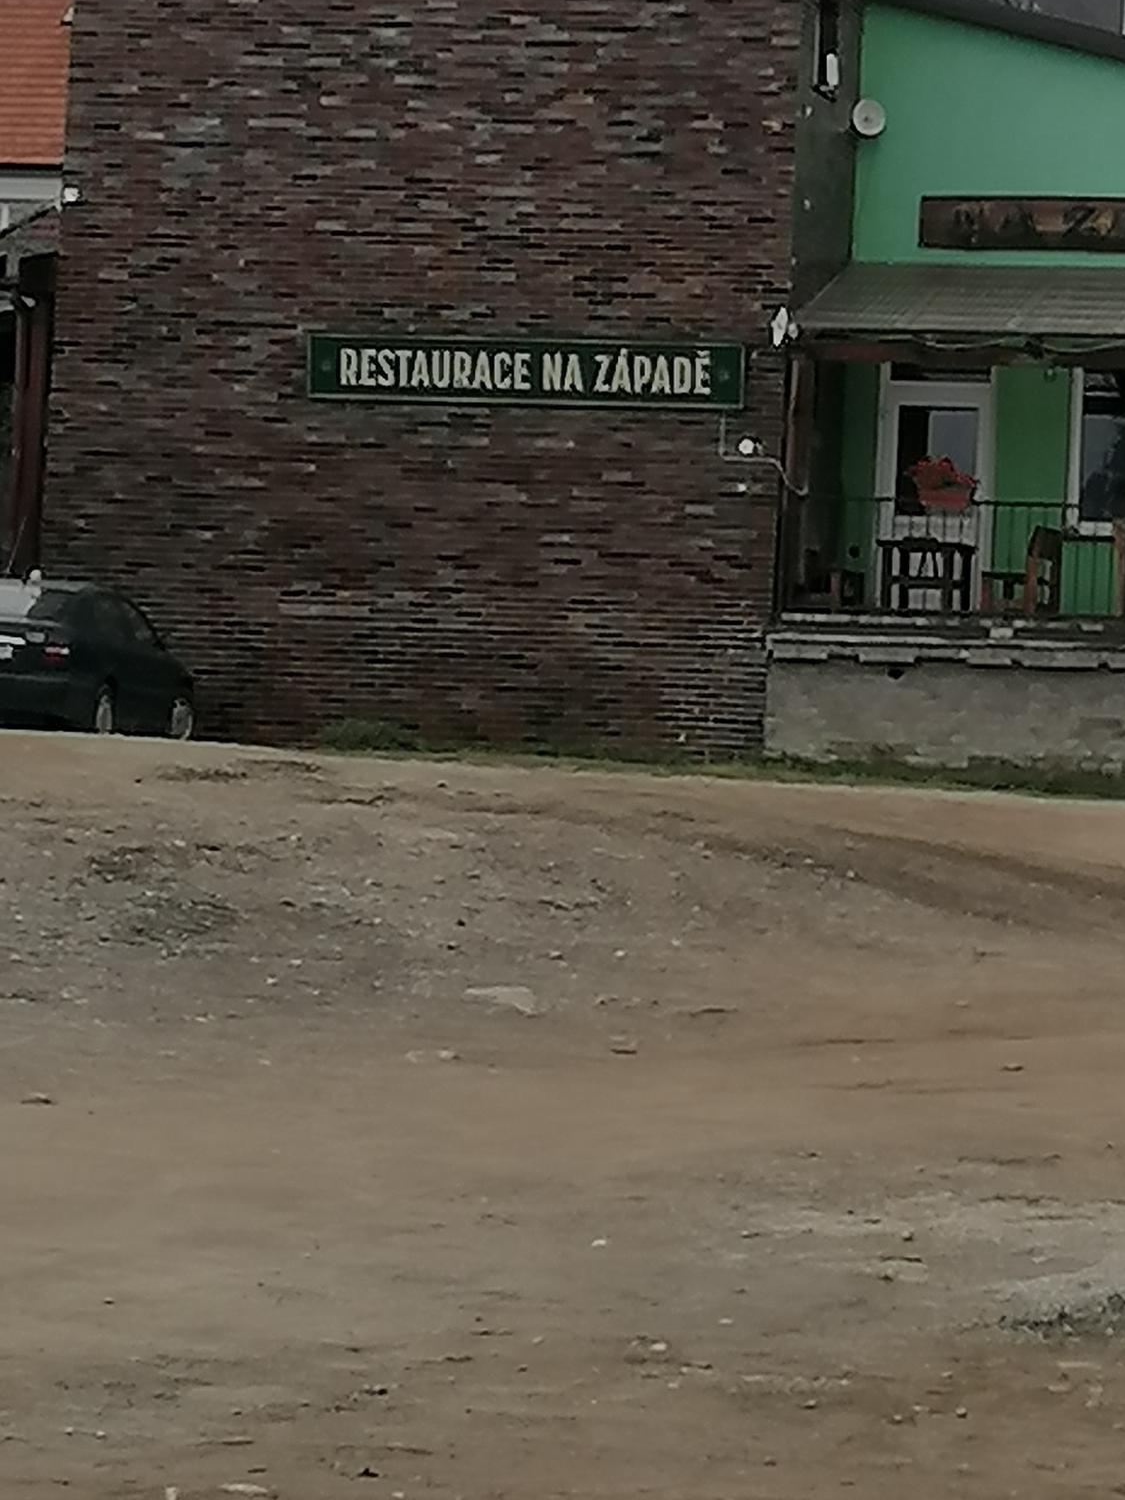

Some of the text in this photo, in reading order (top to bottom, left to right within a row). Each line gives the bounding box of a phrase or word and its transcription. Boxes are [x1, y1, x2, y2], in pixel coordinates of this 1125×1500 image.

[339, 347, 712, 395] RESTAURACE NA ZÁPADĚ
